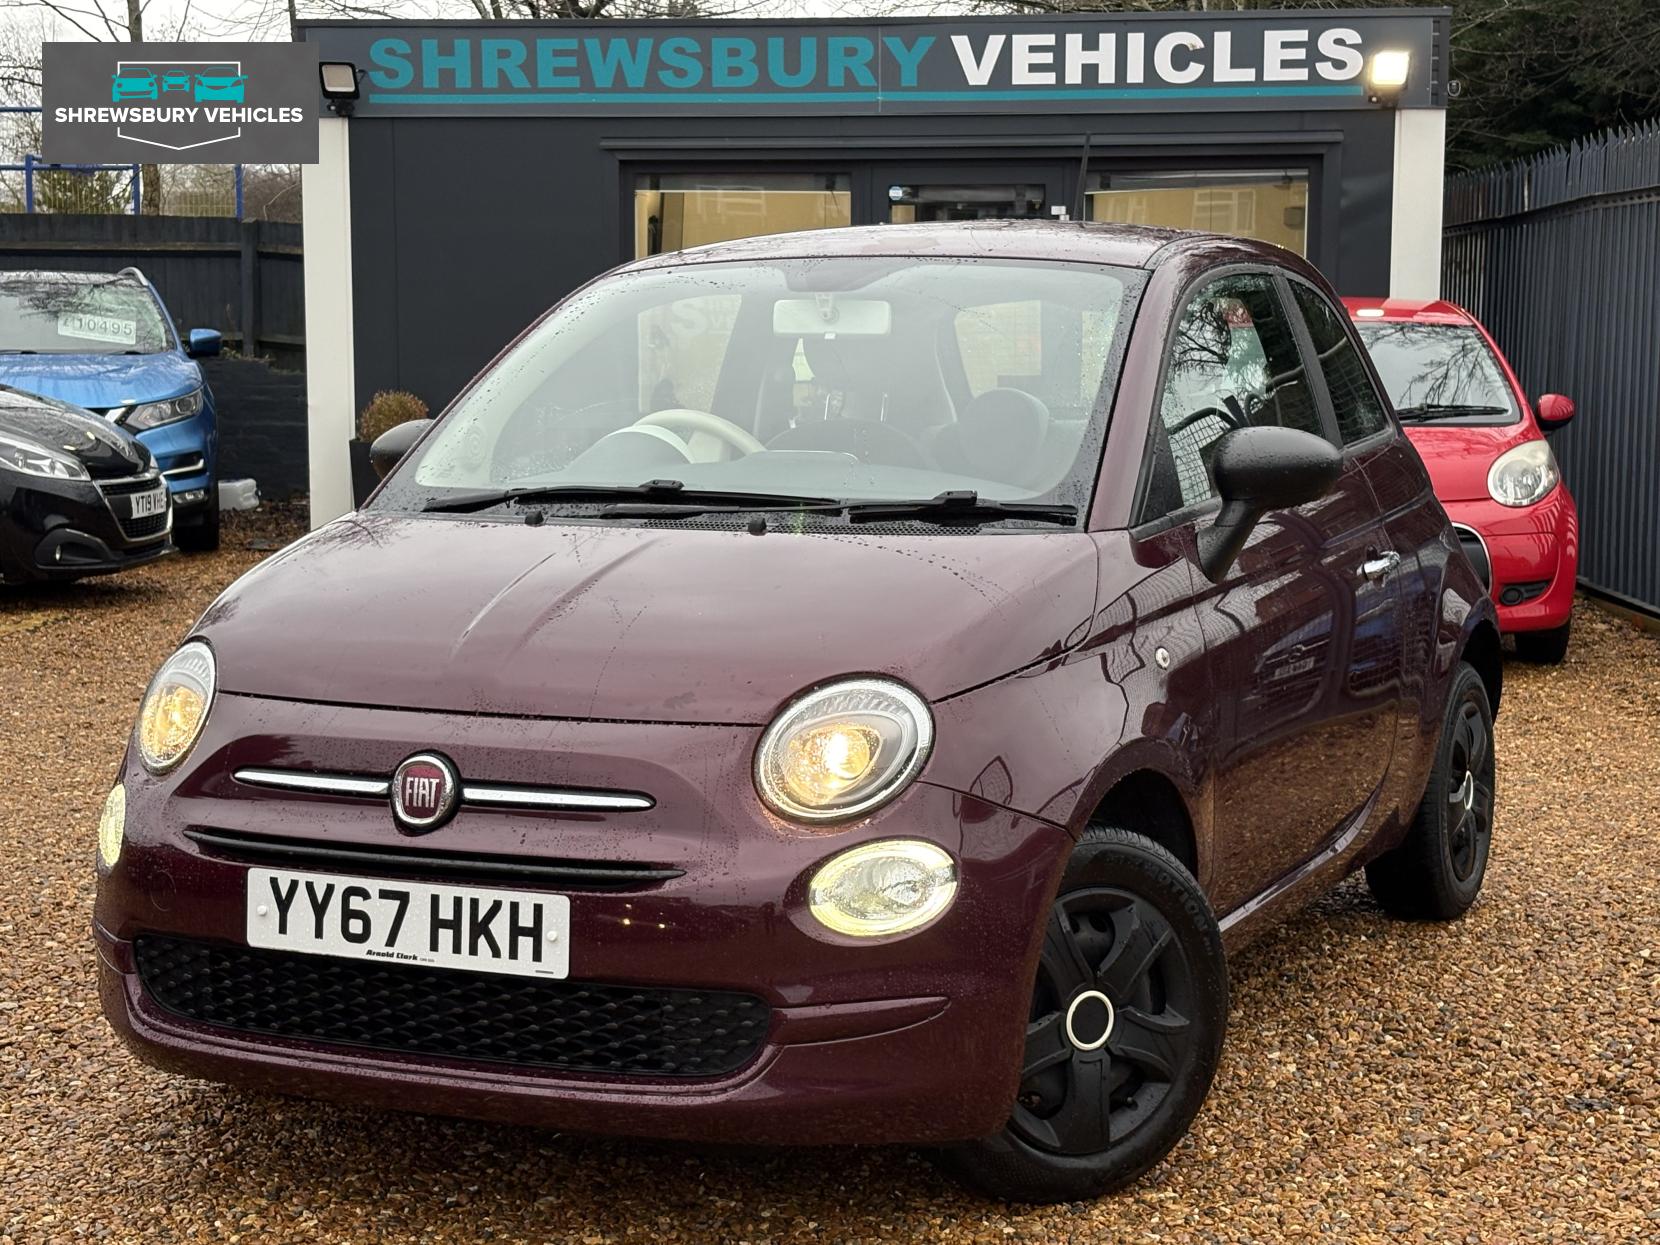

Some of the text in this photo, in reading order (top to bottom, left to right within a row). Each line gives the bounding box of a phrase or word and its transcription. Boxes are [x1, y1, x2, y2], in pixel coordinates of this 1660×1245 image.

[369, 28, 1364, 89] SHREWSBURY VEHICLES
[135, 494, 152, 514] YT19
[405, 777, 440, 808] FIAT
[269, 876, 544, 963] YY67 HKH
[366, 949, 395, 958] Arnold
